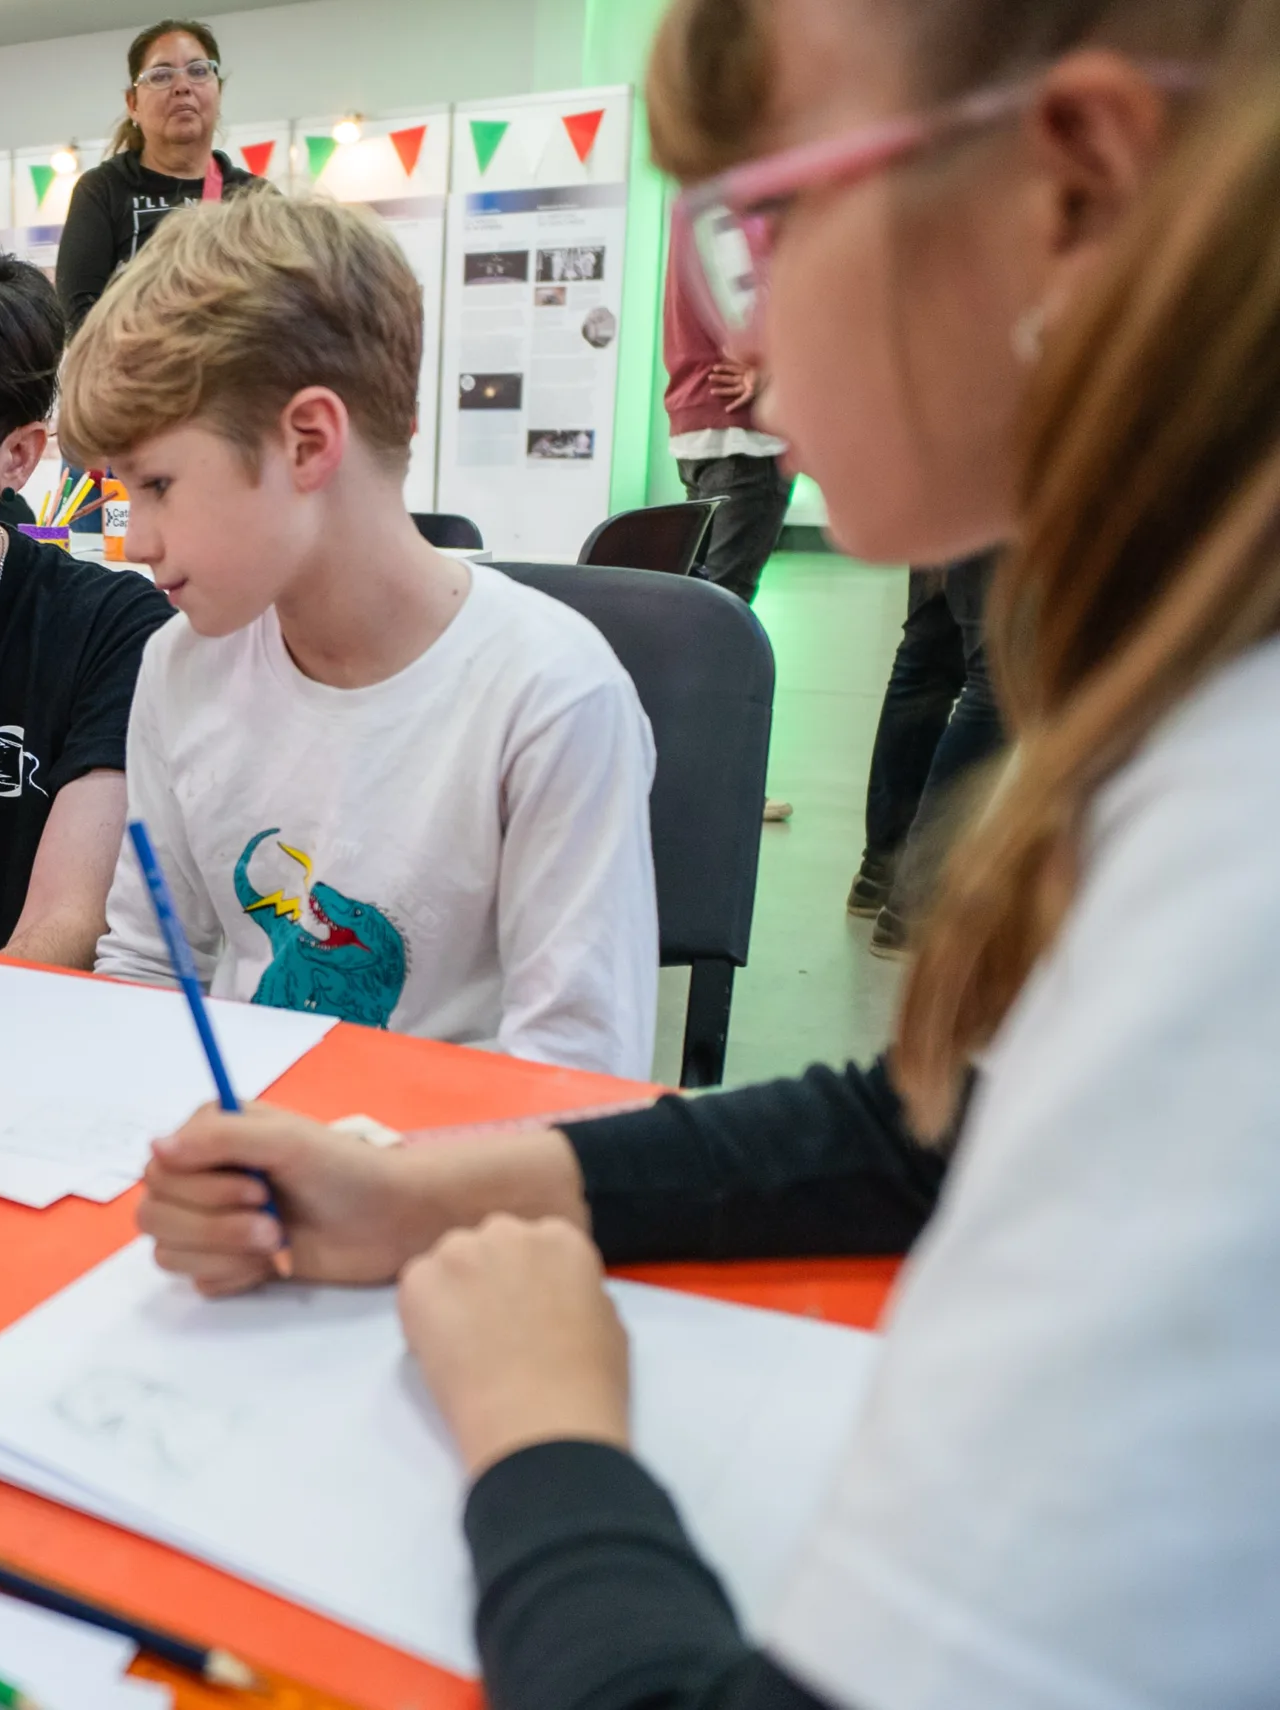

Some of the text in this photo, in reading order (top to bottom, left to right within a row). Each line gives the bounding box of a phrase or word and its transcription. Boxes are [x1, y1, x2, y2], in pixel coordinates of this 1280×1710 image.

[132, 195, 198, 209] I'LL N
[113, 508, 129, 518] Cat
